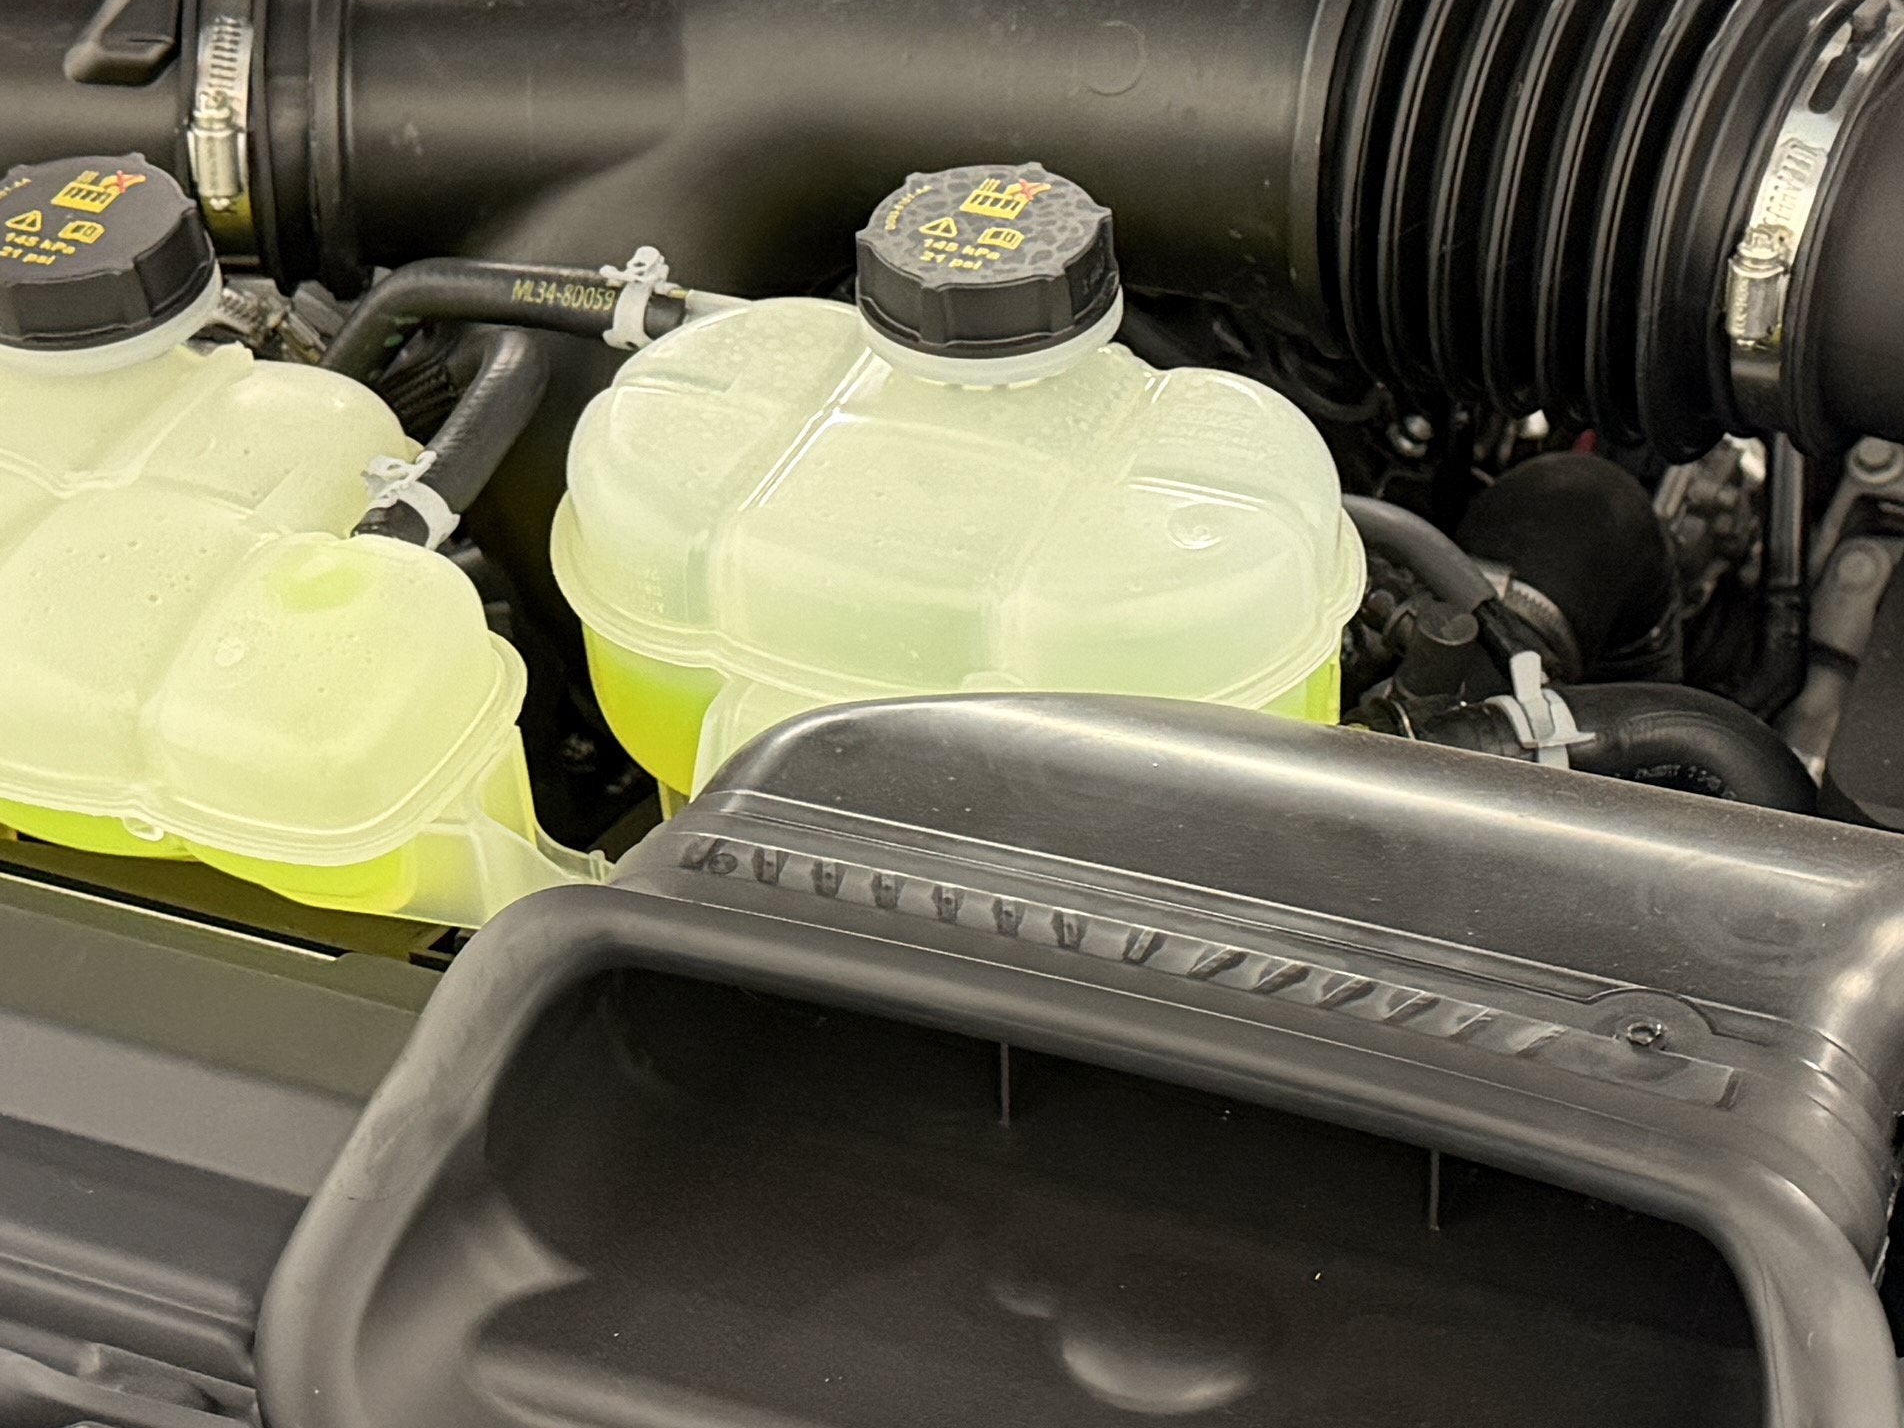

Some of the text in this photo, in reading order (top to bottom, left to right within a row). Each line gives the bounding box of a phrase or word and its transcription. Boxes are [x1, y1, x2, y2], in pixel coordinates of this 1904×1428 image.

[39, 238, 77, 255] kPa
[922, 238, 1002, 261] 145 kPa
[22, 252, 57, 266] psi
[919, 250, 983, 271] 21 psi
